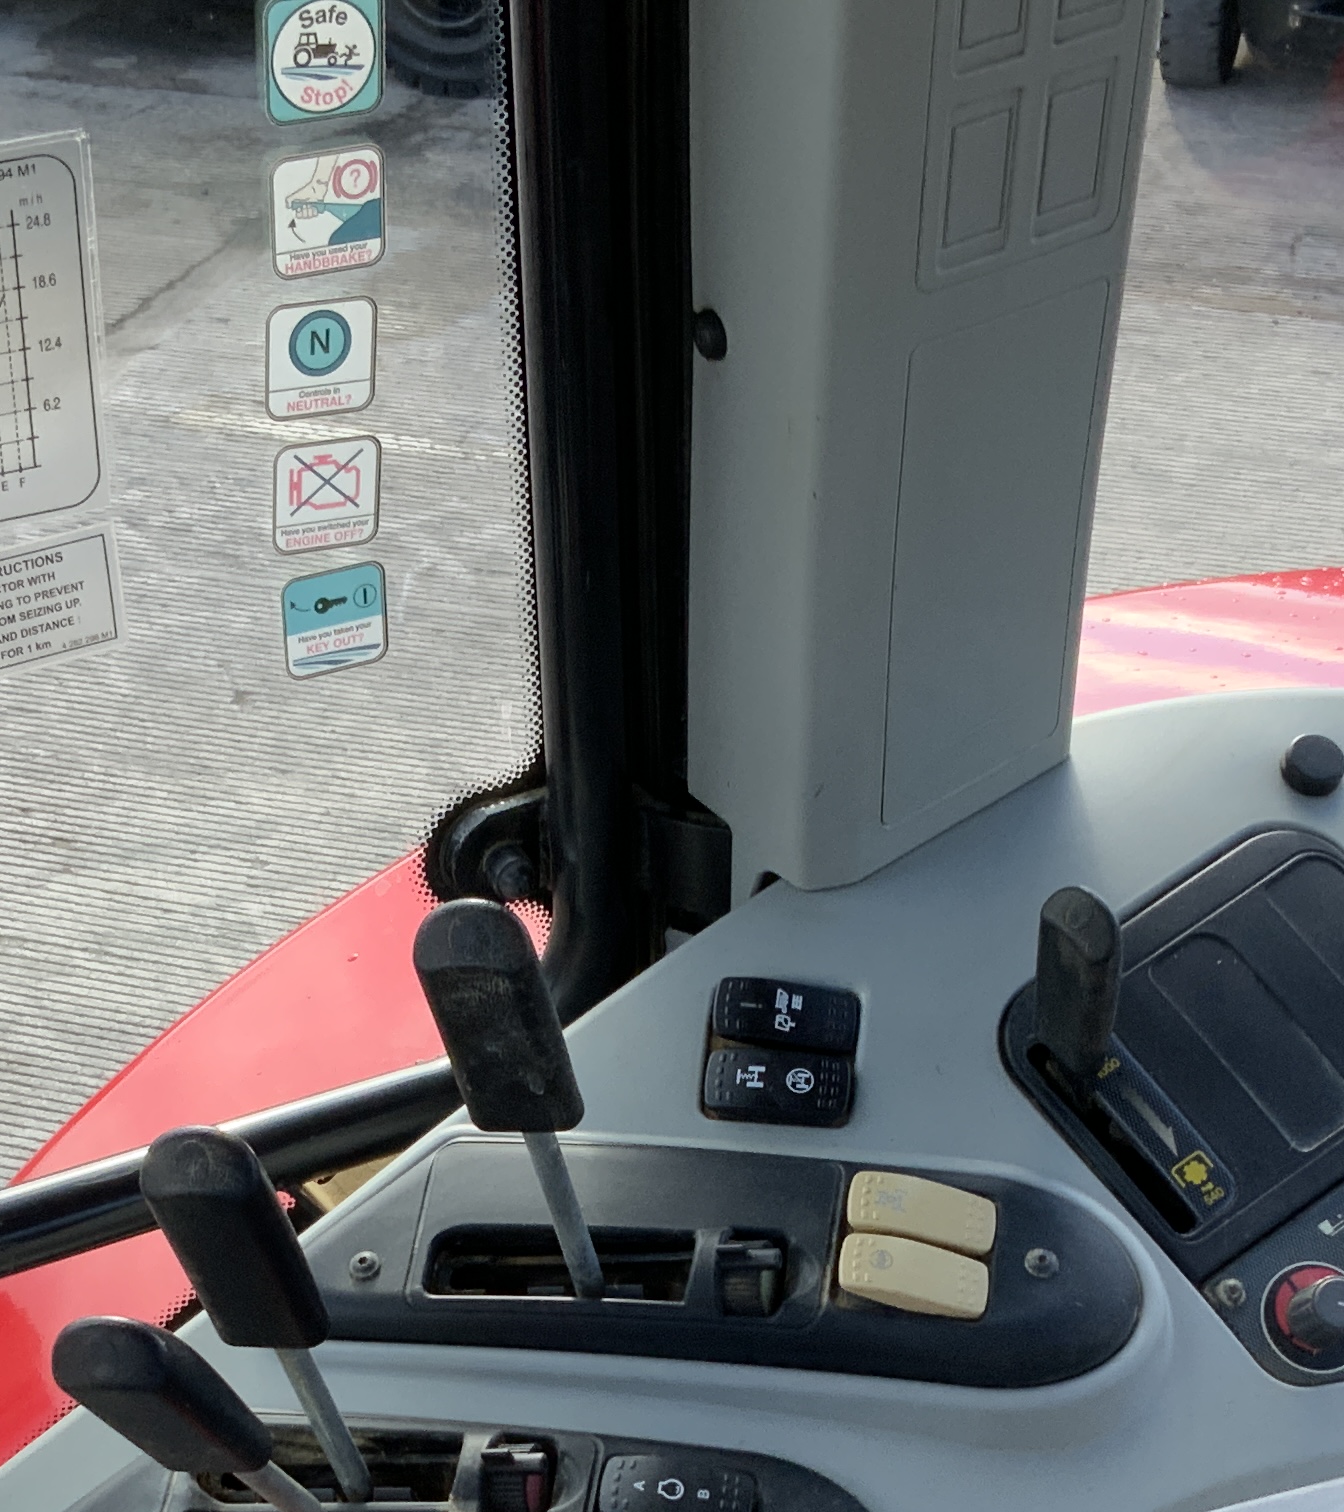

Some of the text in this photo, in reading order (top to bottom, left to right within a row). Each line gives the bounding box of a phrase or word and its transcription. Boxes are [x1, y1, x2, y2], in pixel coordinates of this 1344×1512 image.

[298, 4, 348, 29] Safe
[300, 79, 354, 106] Stop!
[17, 163, 37, 177] M1
[26, 212, 51, 230] 24.8
[284, 249, 372, 274] HANDBRAKE?
[33, 273, 57, 290] 18.6
[39, 337, 62, 352] 12.4
[309, 328, 331, 356] N
[43, 397, 61, 412] 6.2
[287, 394, 352, 412] NEUTRAL?
[1, 481, 9, 492] E
[19, 477, 27, 488] F
[286, 528, 365, 548] ENGINE OFF?
[27, 571, 56, 586] WITH
[16, 593, 32, 607] TO
[34, 581, 85, 601] PREVENT
[19, 602, 63, 622] SEIZING
[20, 616, 75, 638] DISTANCE
[0, 646, 24, 660] FOR
[27, 643, 33, 654] 1
[34, 640, 52, 651] km
[306, 641, 330, 655] KEY
[633, 1480, 710, 1500] A B
